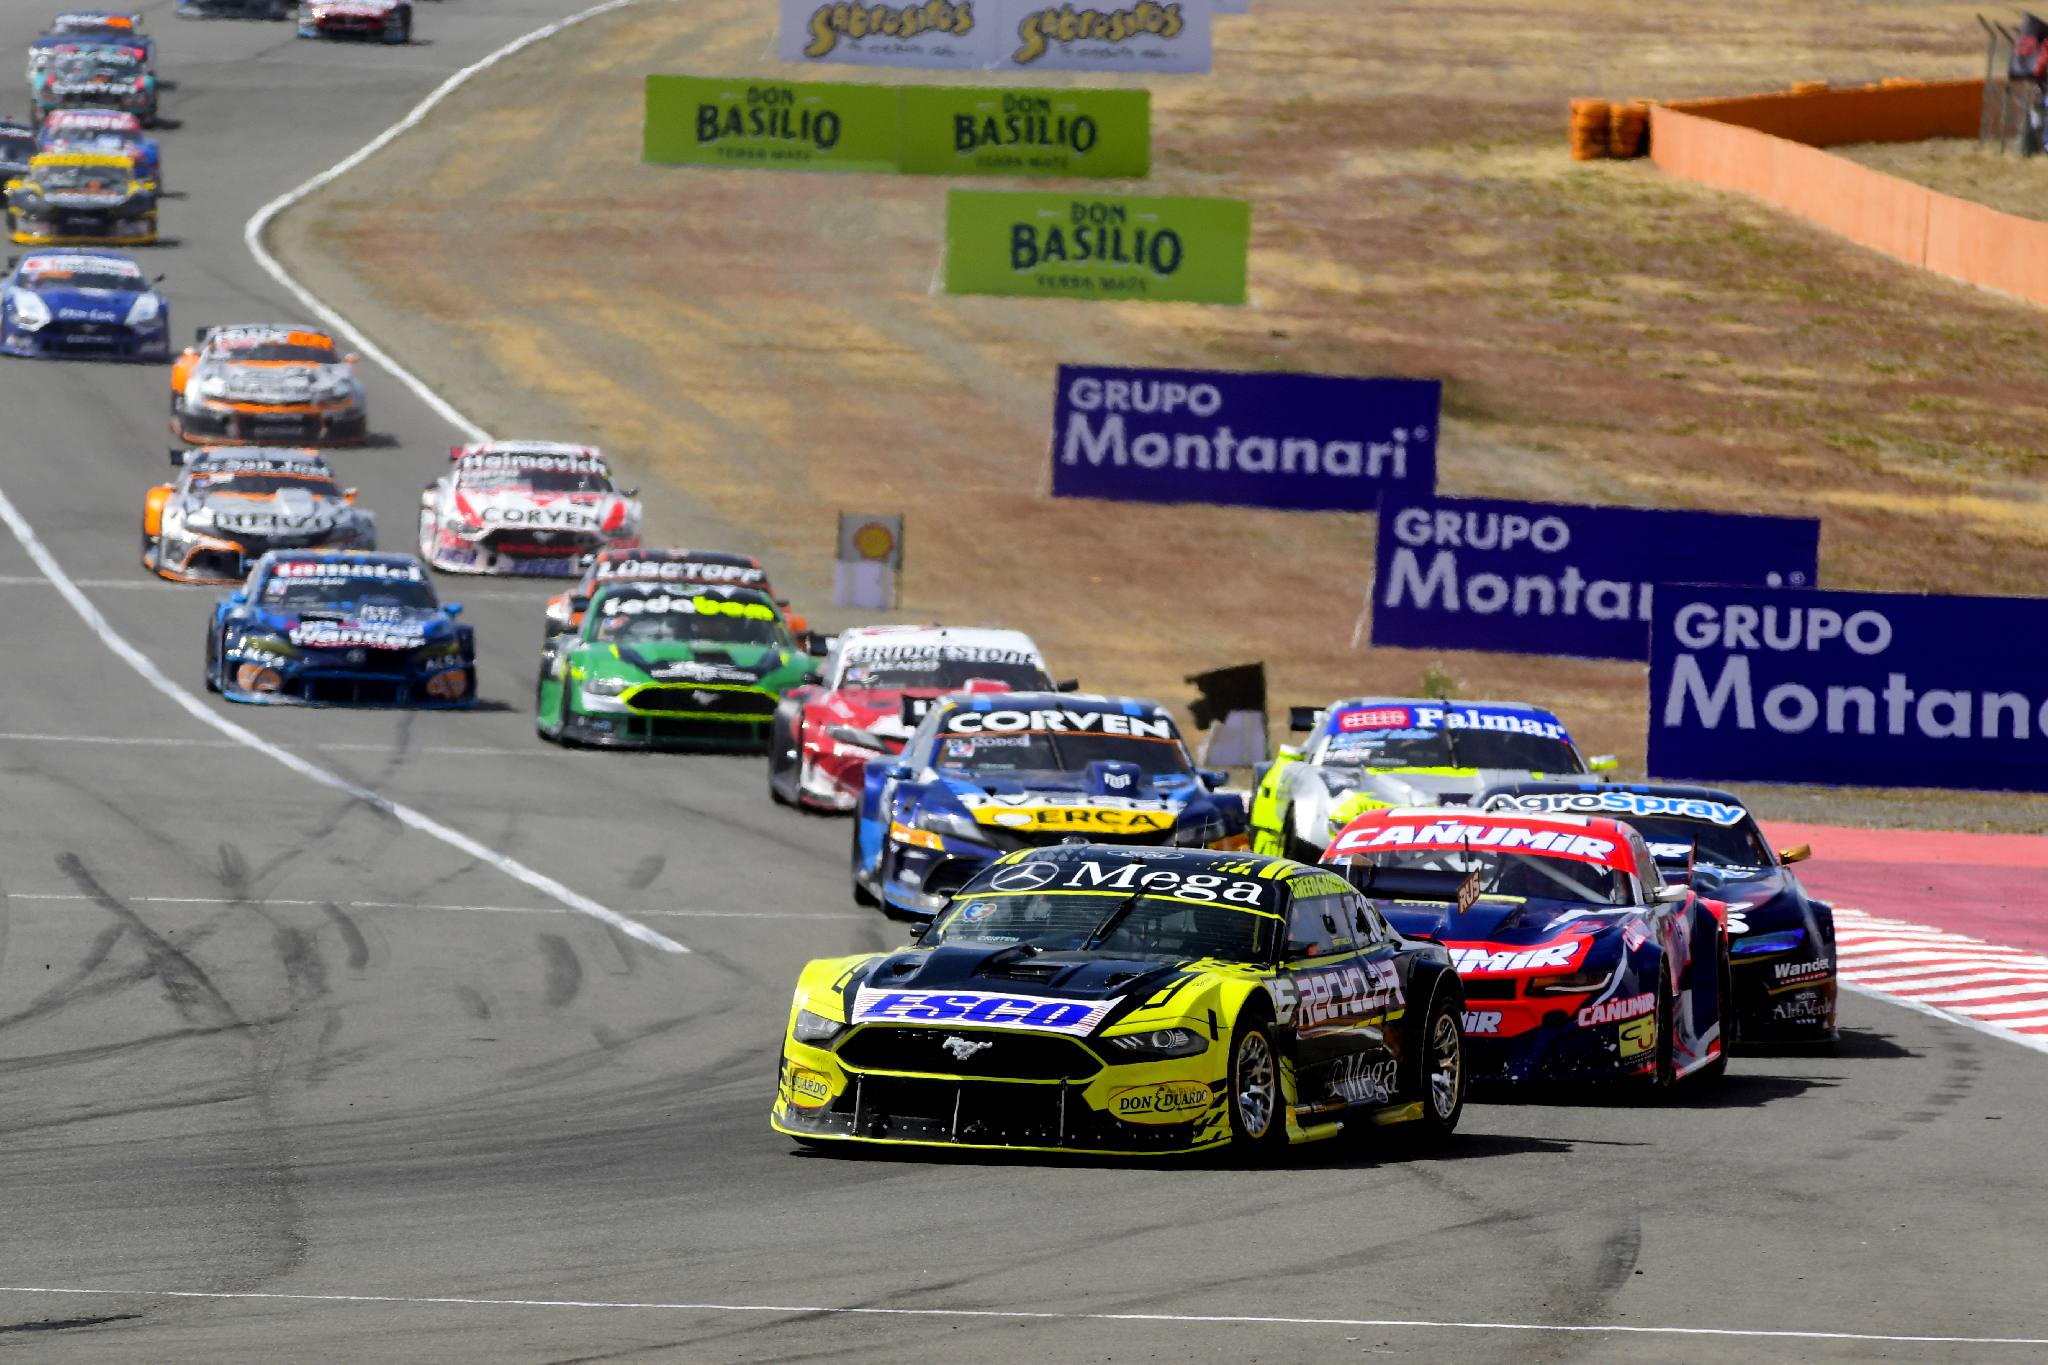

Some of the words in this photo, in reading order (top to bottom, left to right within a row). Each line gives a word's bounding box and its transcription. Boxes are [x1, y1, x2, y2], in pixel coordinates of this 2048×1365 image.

[747, 86, 795, 106] DON
[1002, 93, 1052, 114] DON
[696, 103, 840, 148] BASILIO
[955, 112, 1096, 152] BASILIO
[1071, 202, 1127, 225] DON
[1011, 222, 1183, 275] BASILIO
[1068, 377, 1222, 417] GRUPO
[1061, 411, 1408, 479] Montanari
[483, 507, 600, 527] CORVEN
[1394, 508, 1571, 553] GRUPO
[1673, 602, 1893, 656] GRUPO
[1663, 652, 2048, 740] Montan
[948, 709, 1171, 739] CORVEN
[1413, 706, 1567, 740] Palmar
[1481, 791, 1747, 825] AgroSpray
[1063, 860, 1264, 906] Mega
[861, 992, 1097, 1027] ESCO
[1120, 1095, 1152, 1110] DON
[1154, 1086, 1208, 1112] EDUARDO
